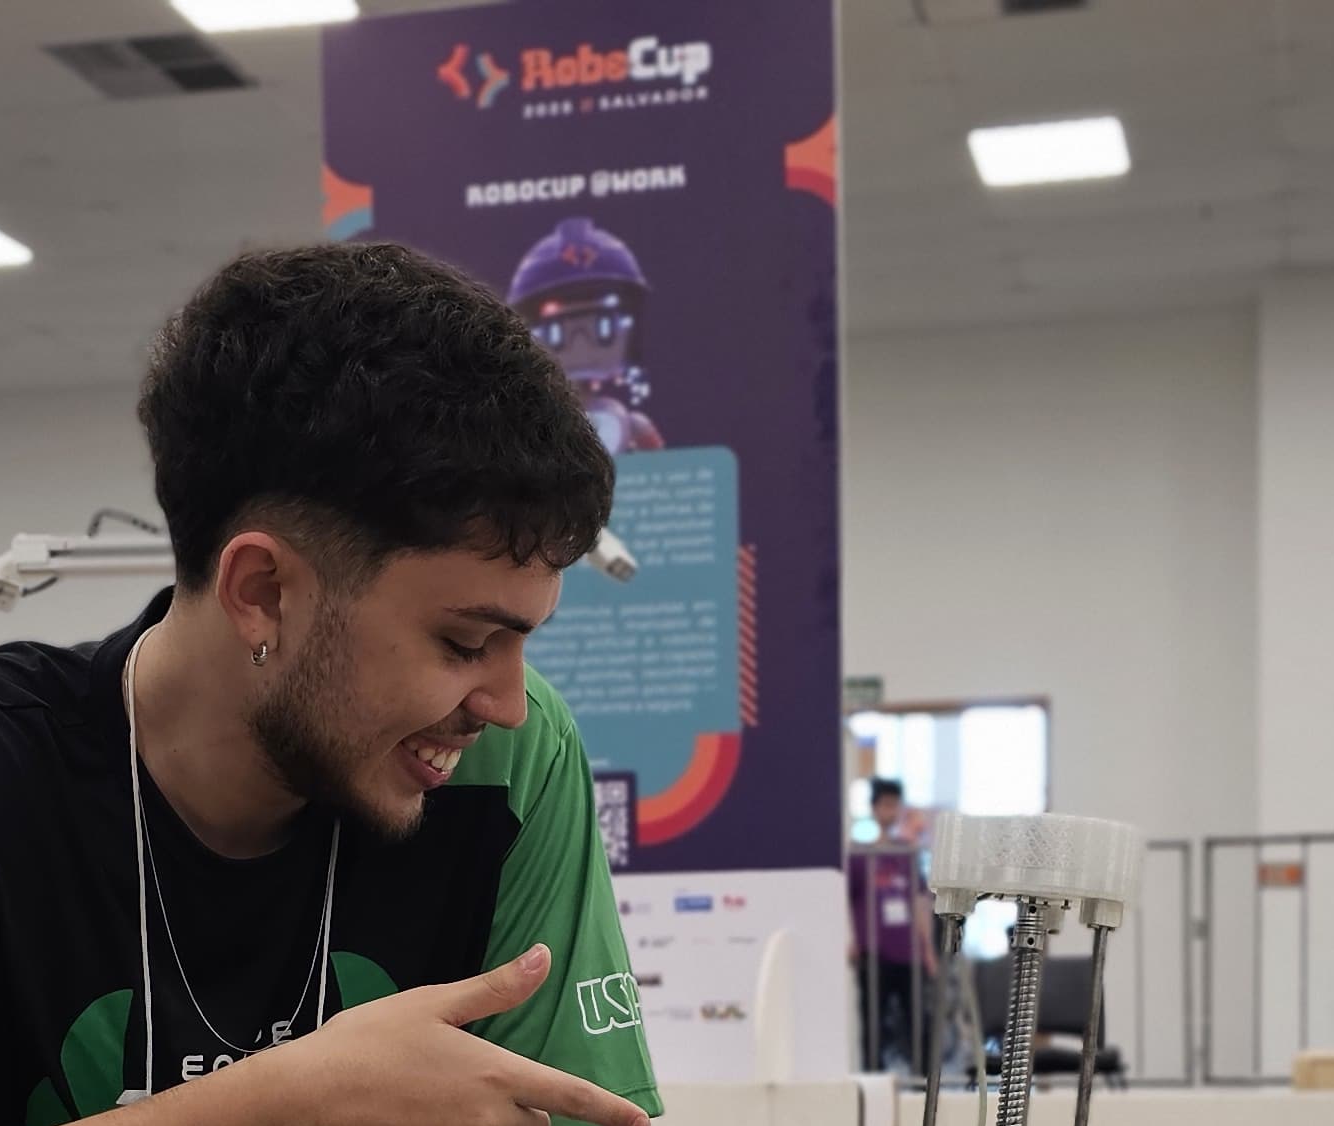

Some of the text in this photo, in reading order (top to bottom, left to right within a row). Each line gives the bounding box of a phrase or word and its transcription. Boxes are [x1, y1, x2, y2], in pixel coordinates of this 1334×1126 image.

[521, 34, 712, 91] RoboCup
[466, 165, 686, 207] ROBOCUP @WORK
